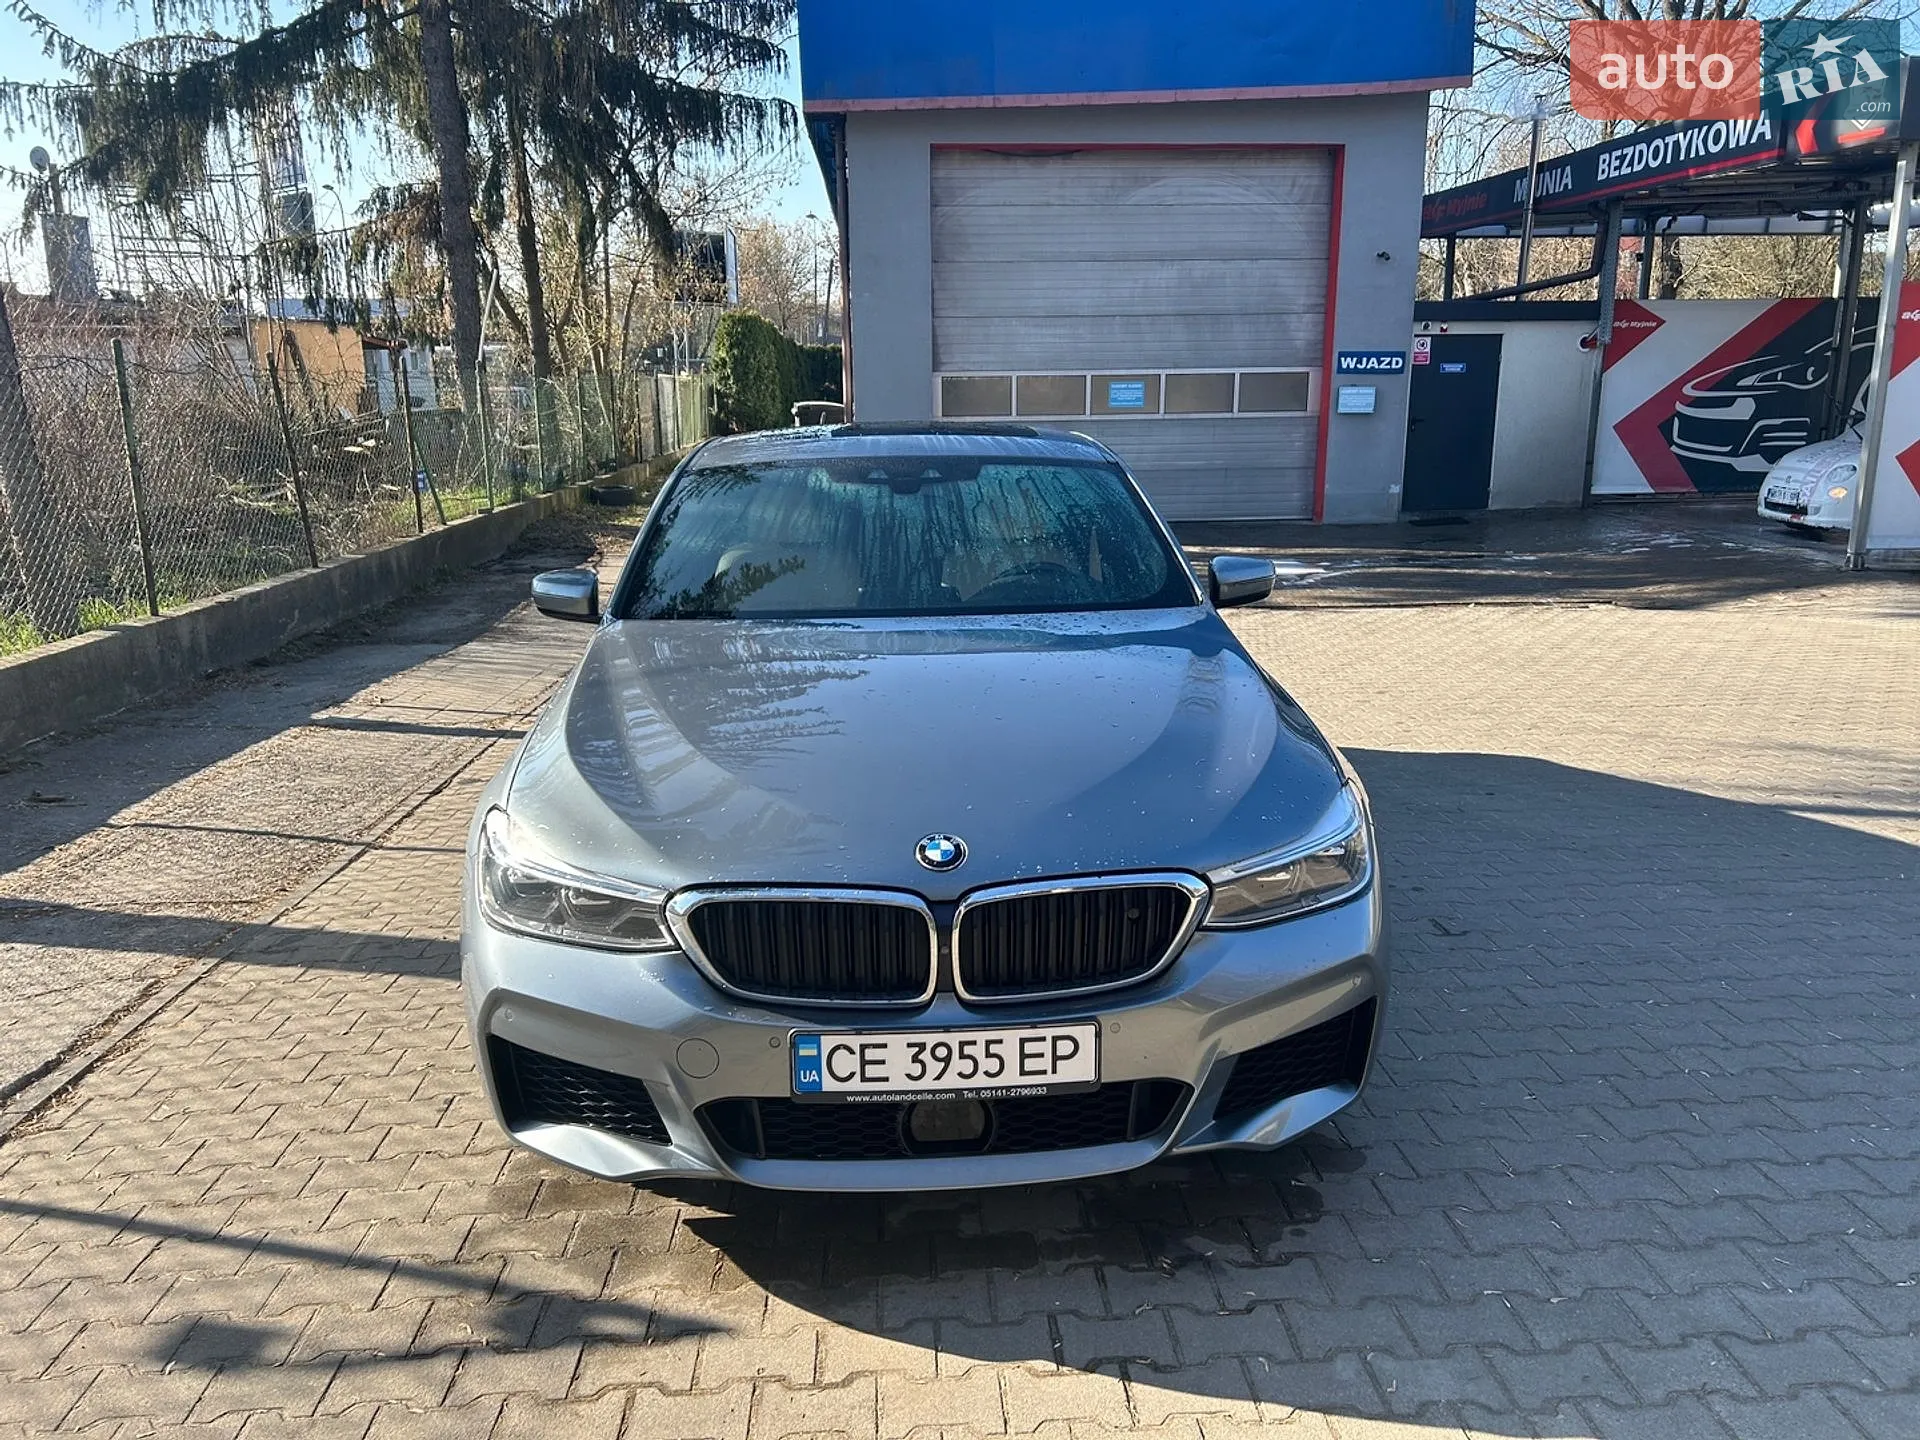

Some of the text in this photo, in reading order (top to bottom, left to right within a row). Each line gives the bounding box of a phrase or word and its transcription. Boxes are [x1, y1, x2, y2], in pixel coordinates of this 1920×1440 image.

[1597, 109, 1772, 182] BEZDOTYKOWA
[1340, 357, 1403, 369] WJAZD
[826, 1034, 1080, 1083] CE 3955 EP
[800, 1069, 820, 1083] UA
